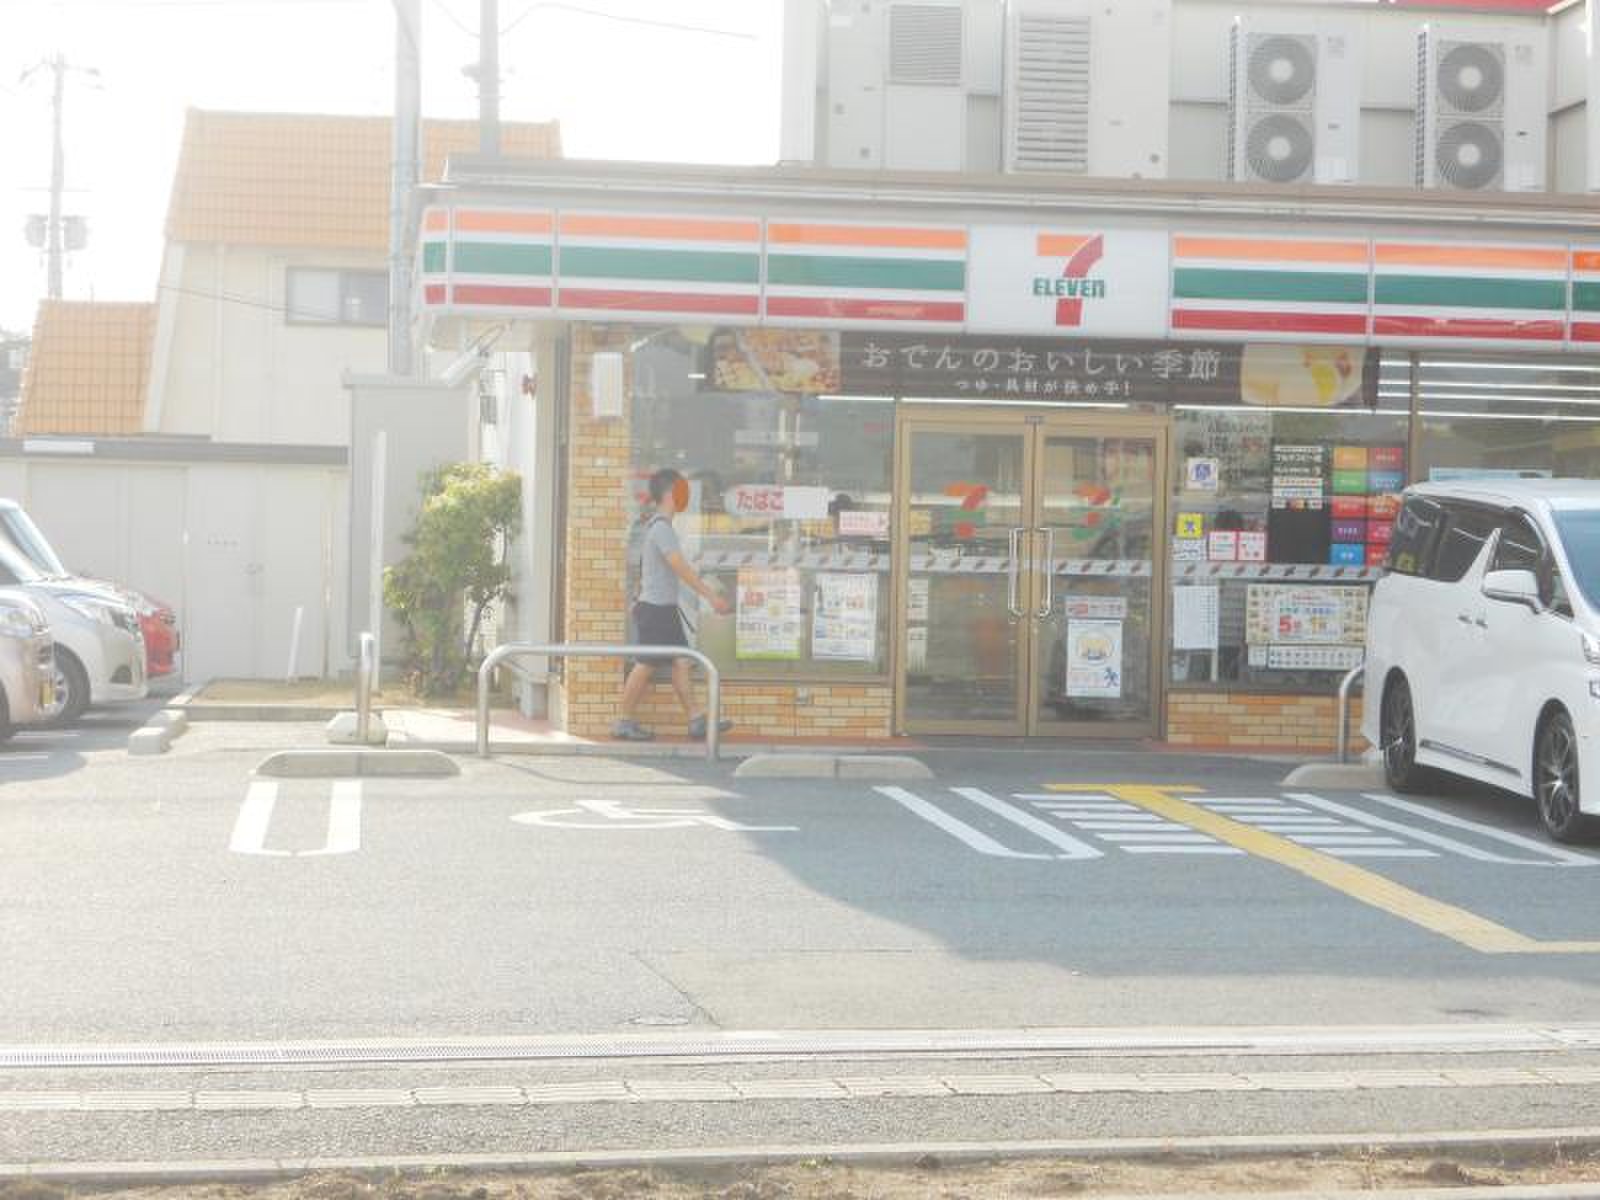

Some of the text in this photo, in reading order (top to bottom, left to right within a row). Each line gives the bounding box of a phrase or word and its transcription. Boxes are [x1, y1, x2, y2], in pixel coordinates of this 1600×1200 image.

[862, 342, 1221, 382] おでんのおいしい季節
[735, 488, 785, 513] たばこ
